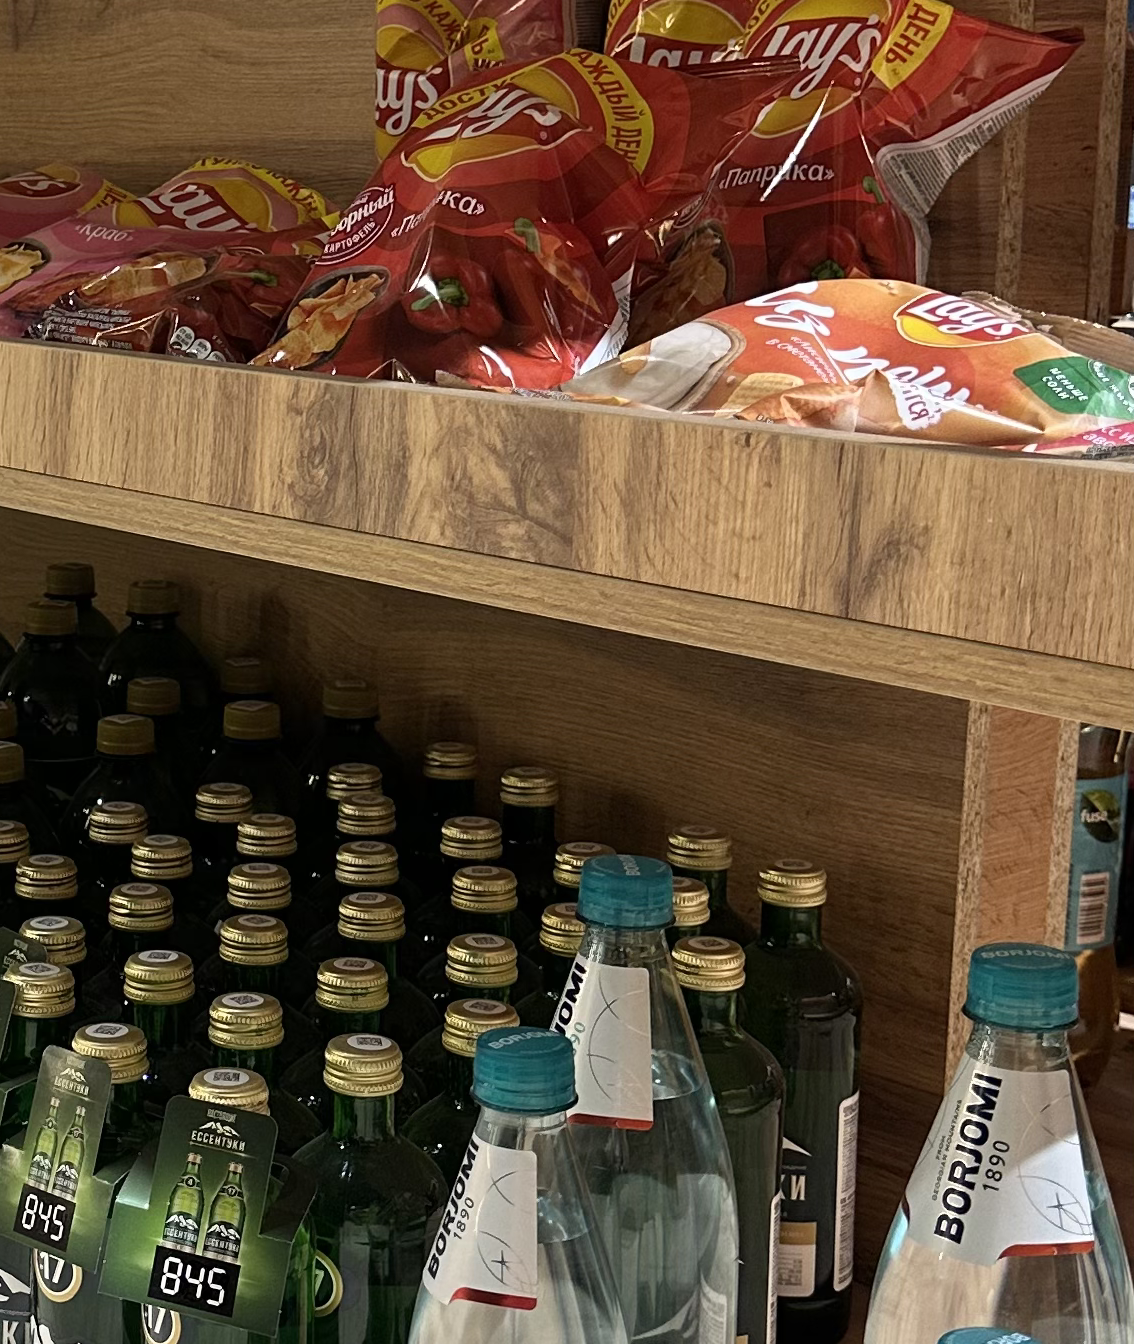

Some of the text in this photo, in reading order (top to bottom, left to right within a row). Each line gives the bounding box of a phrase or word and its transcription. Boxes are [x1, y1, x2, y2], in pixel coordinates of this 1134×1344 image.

[552, 960, 588, 1035] JOMI
[191, 1129, 246, 1152] ЕССЕНТУКИ
[933, 1072, 1003, 1246] BORJOMI
[982, 1139, 1011, 1192] 1890
[21, 1193, 67, 1242] 845
[426, 1138, 481, 1281] BORJOMI
[452, 1196, 477, 1241] 1890
[160, 1255, 227, 1307] 845
